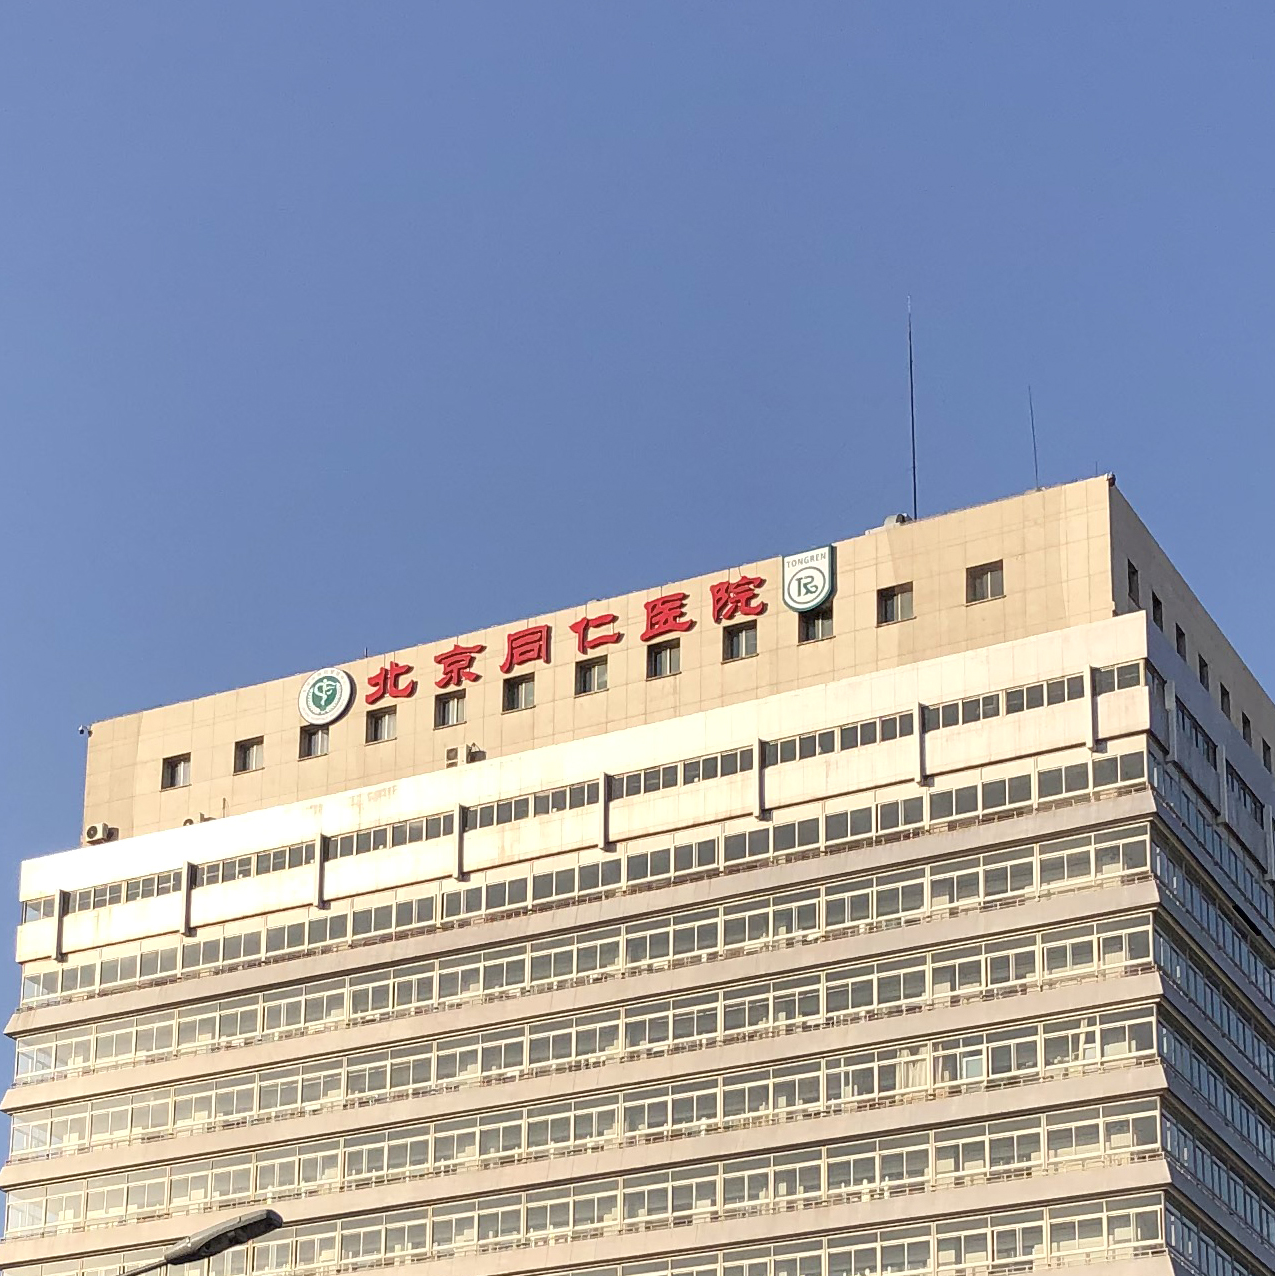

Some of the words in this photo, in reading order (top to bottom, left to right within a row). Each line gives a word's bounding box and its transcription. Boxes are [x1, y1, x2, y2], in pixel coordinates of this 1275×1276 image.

[786, 552, 827, 568] TONGREN
[365, 575, 768, 705] 北京同仁医院
